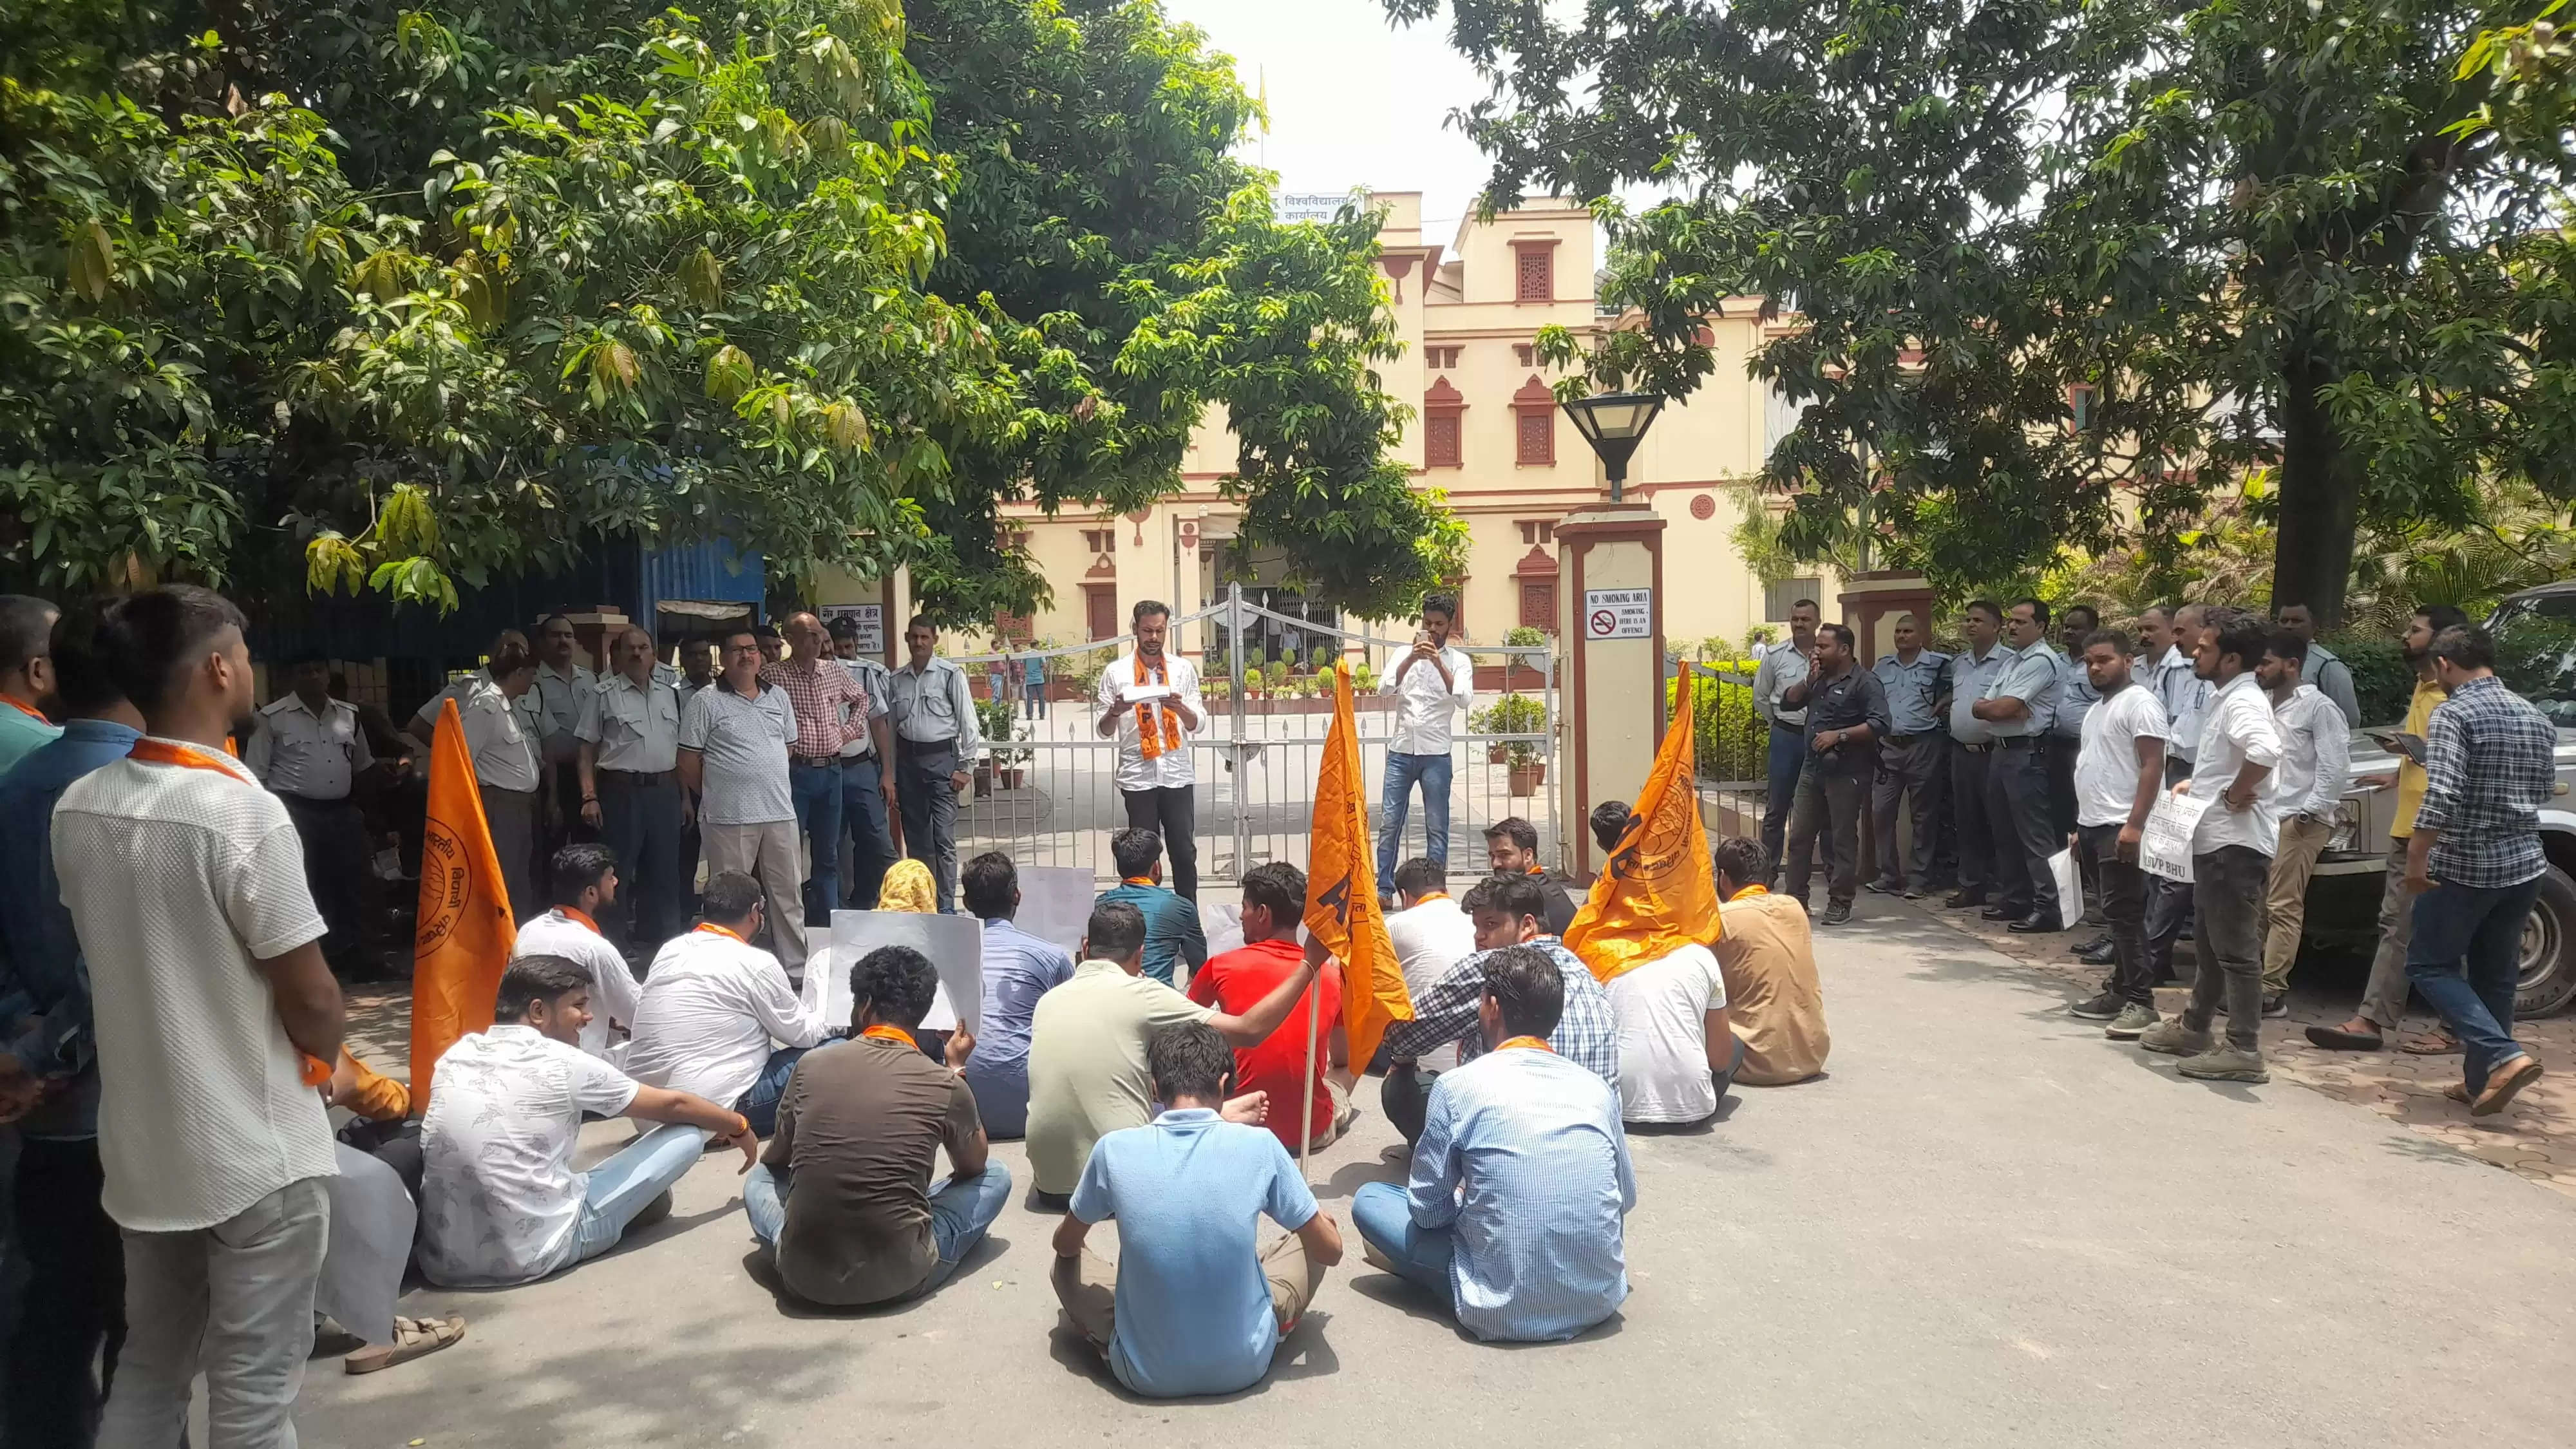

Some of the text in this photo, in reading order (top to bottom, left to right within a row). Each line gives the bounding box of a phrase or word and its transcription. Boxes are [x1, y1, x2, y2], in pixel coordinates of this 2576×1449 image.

[1284, 209, 1327, 220] कार्यालय
[1590, 592, 1647, 604] NO SMOKING AREA
[865, 607, 878, 619] क्षेत्र
[2165, 860, 2186, 878] BHU
